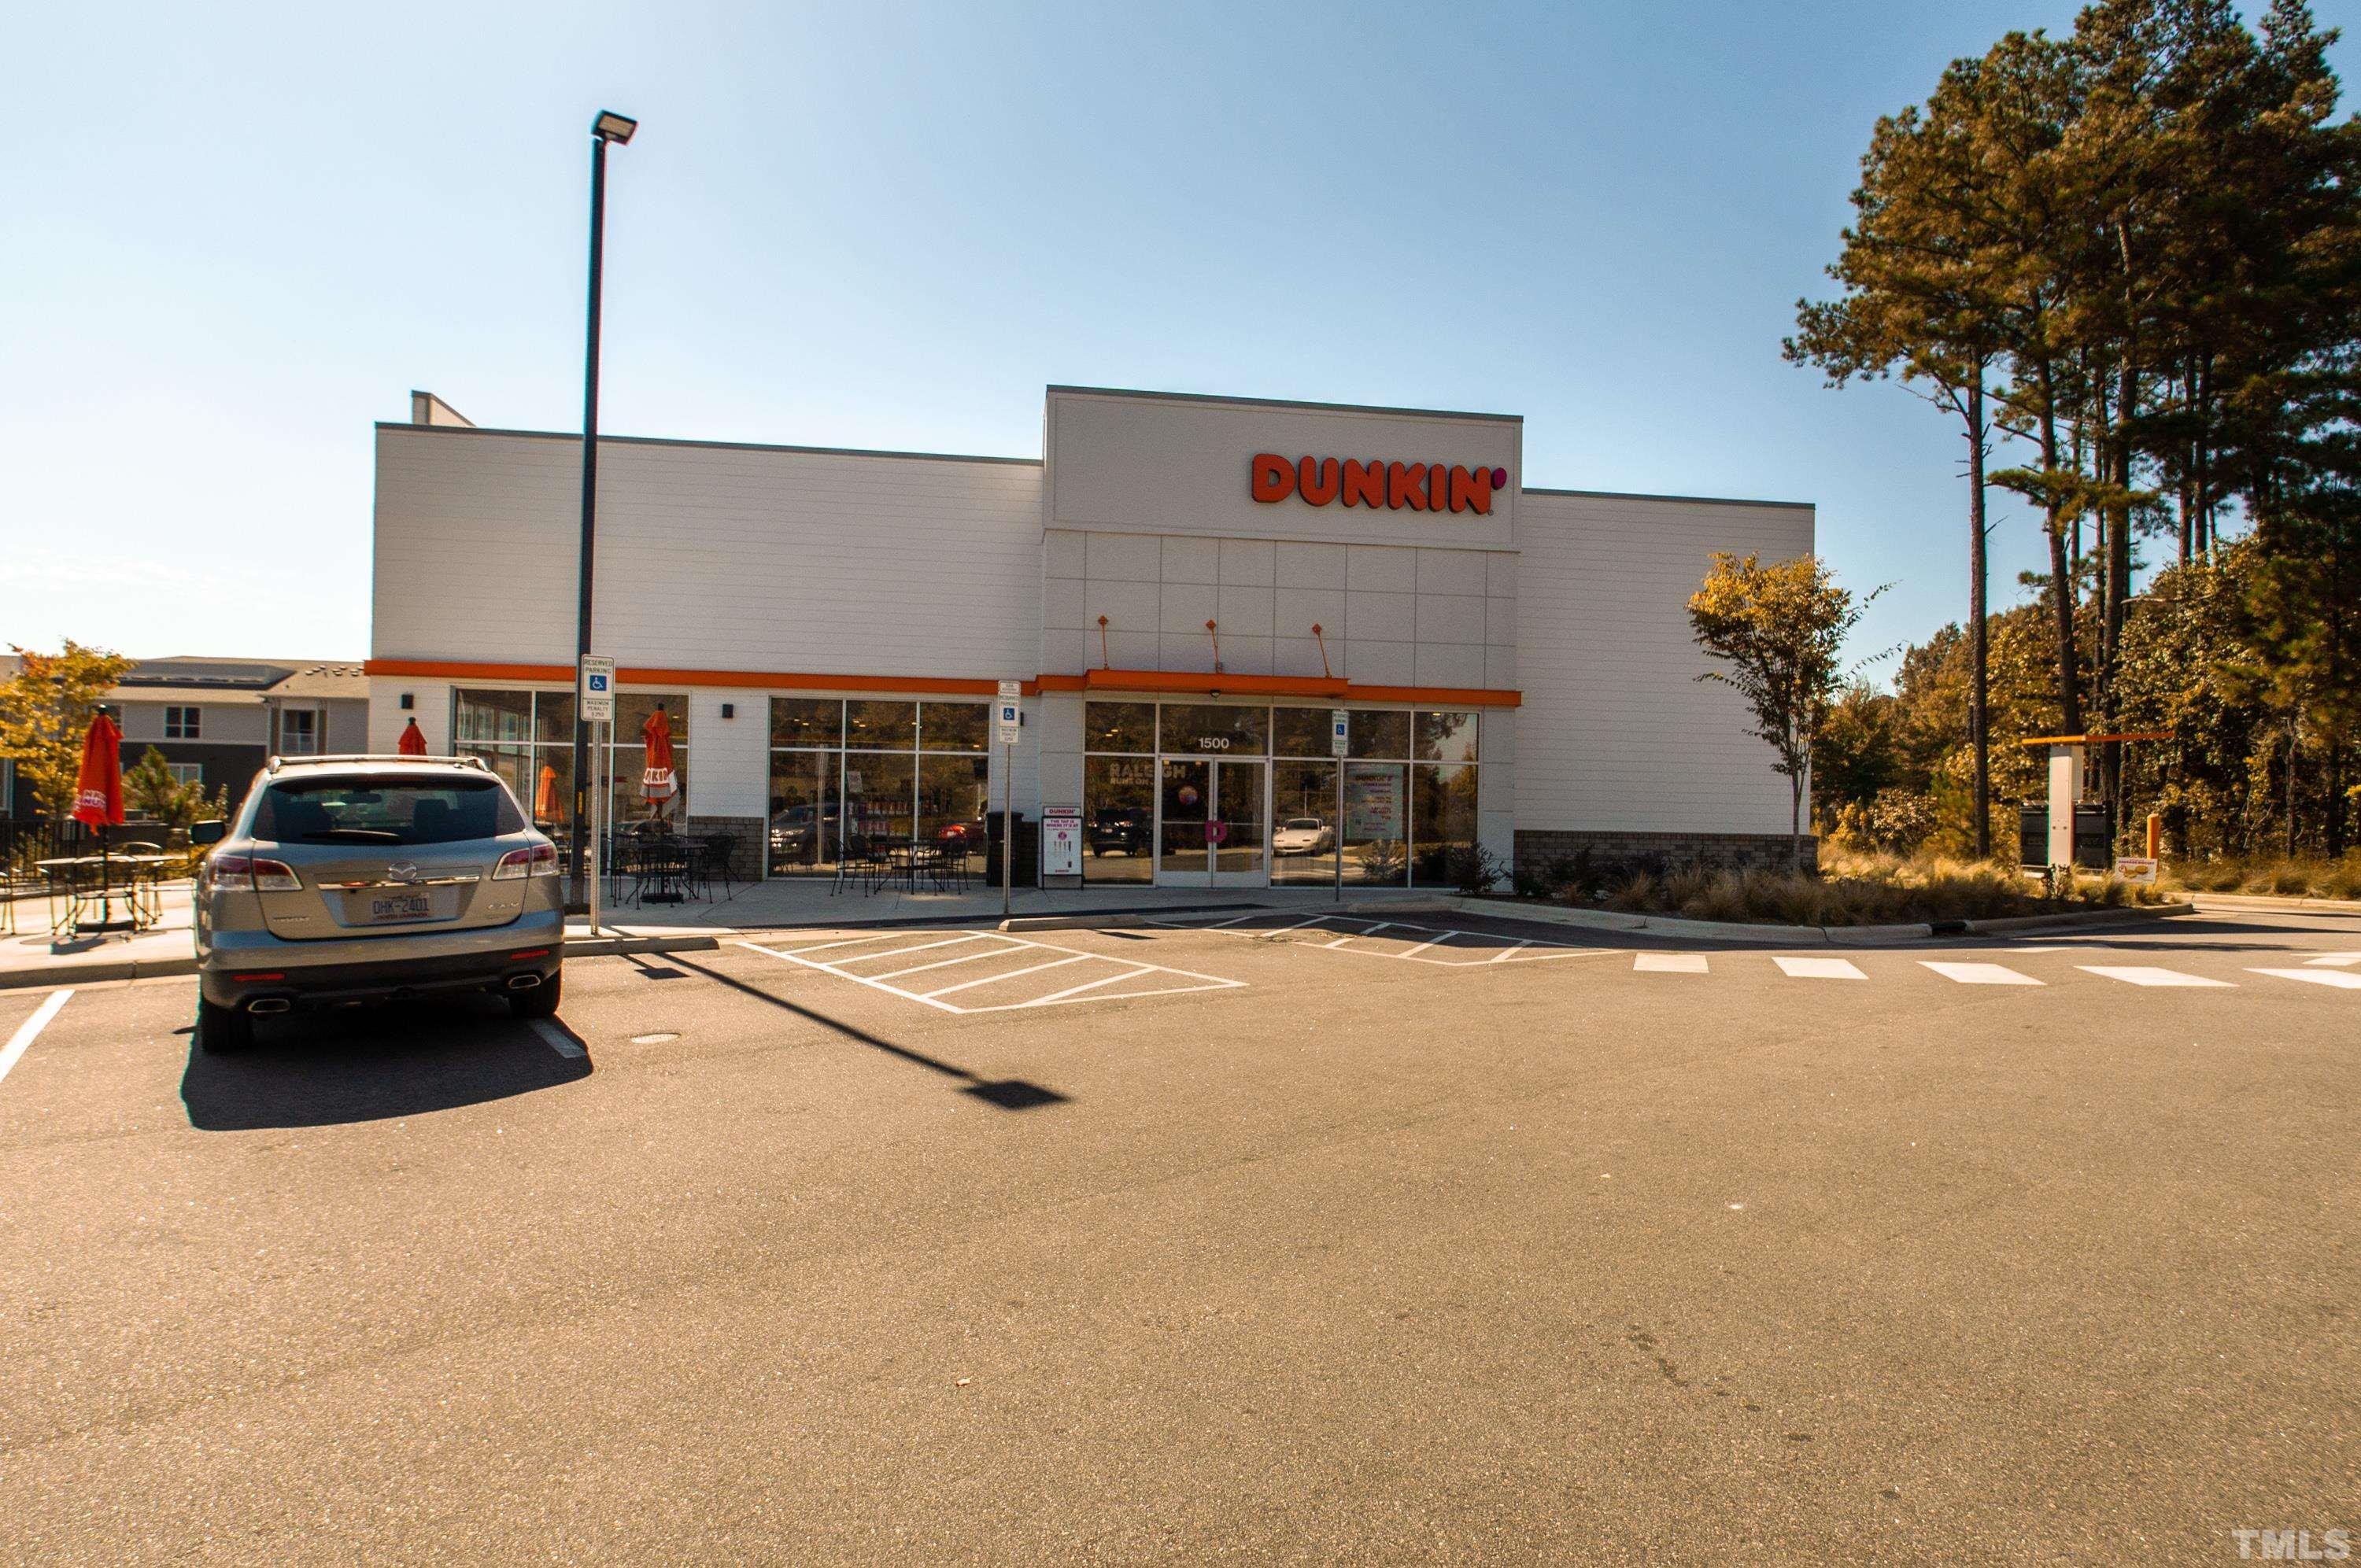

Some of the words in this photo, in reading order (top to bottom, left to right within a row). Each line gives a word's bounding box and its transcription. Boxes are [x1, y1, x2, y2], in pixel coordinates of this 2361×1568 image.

[1251, 453, 1507, 515] DUNKIN'
[1198, 737, 1229, 749] 1500
[1110, 762, 1186, 779] RALEGH
